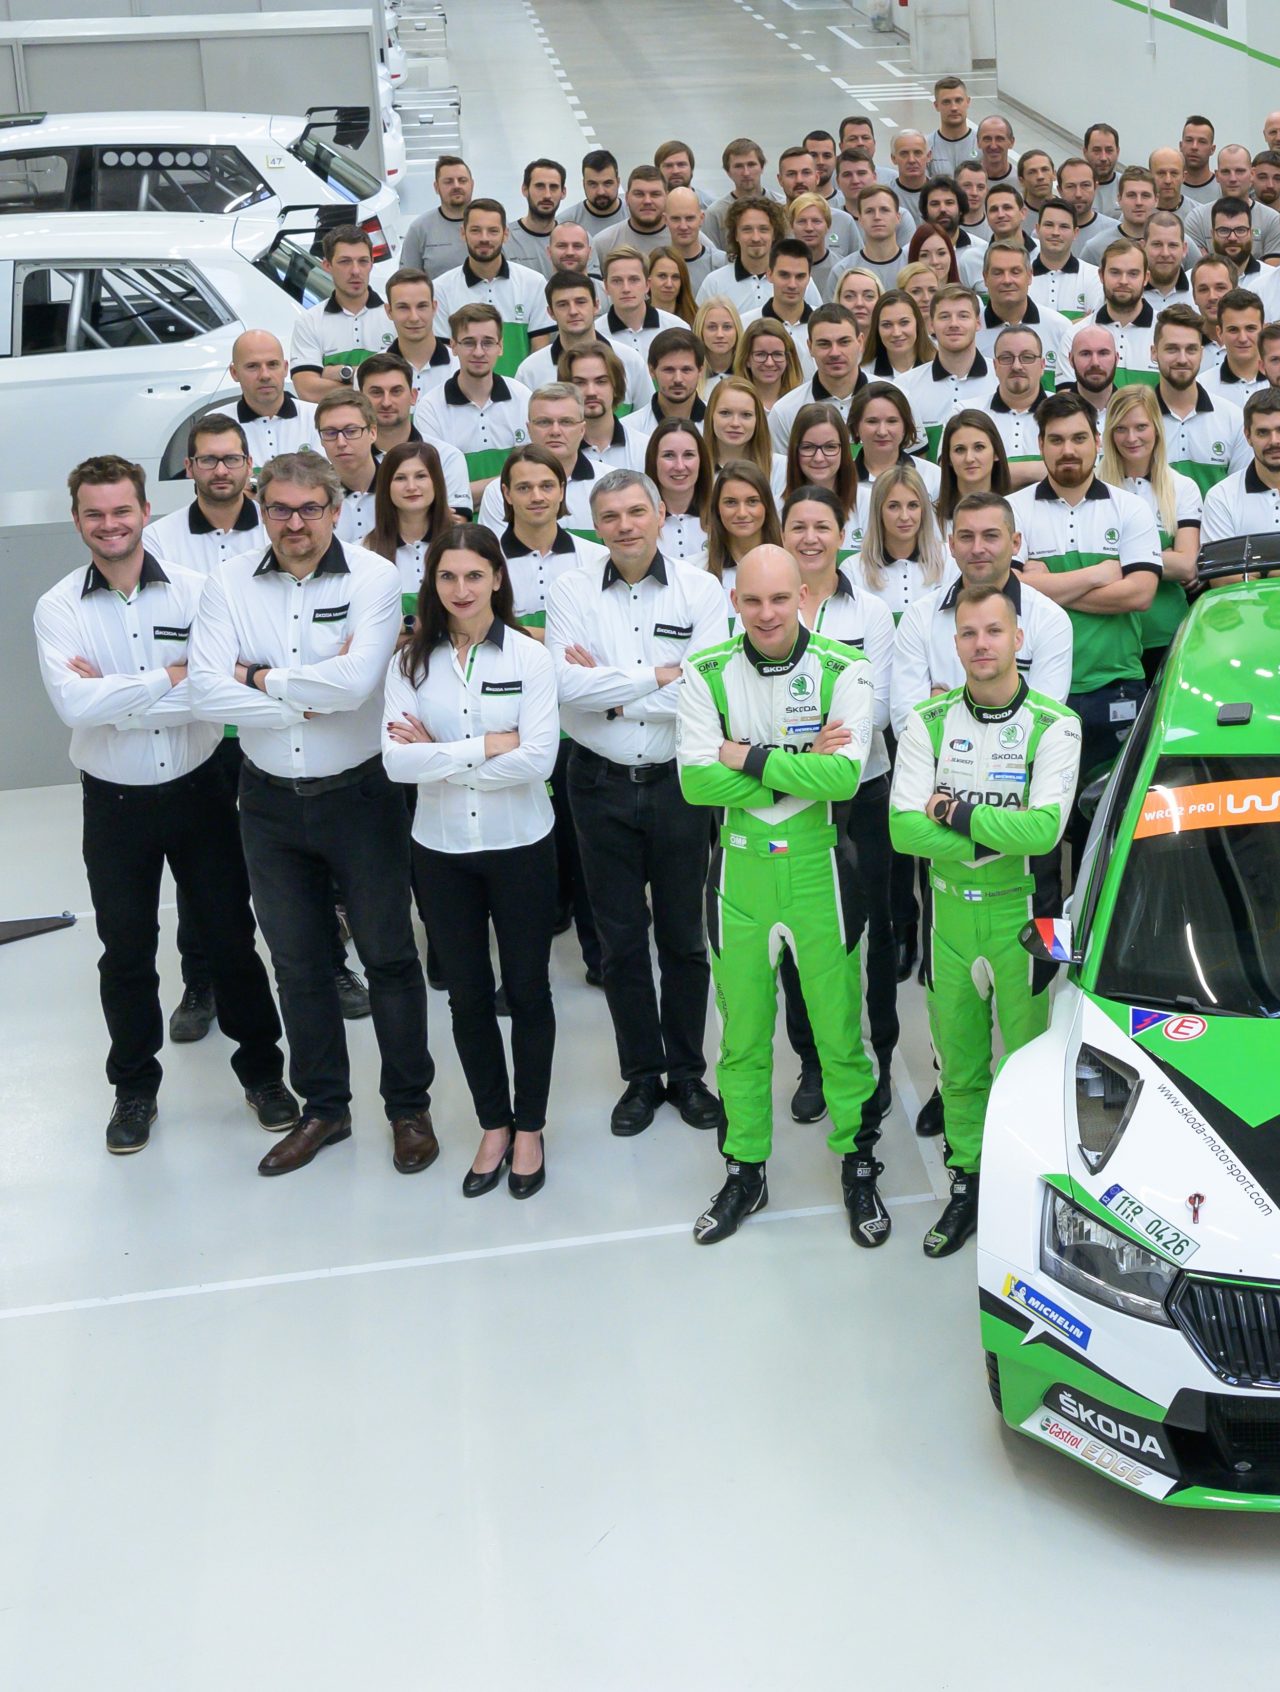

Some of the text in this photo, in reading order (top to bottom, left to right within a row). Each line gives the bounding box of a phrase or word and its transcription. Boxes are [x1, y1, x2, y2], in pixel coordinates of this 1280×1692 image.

[270, 157, 283, 166] 47
[699, 661, 719, 672] OMP
[785, 705, 818, 714] ŠKODA
[936, 782, 1022, 809] ŠKODA
[1188, 803, 1216, 815] PRO
[730, 837, 747, 847] OMP
[1173, 1019, 1200, 1036] E
[1157, 1083, 1273, 1217] www.skoda-motorsport.com
[1115, 1194, 1190, 1257] 11R 0426
[1028, 1295, 1084, 1339] MICHELIN
[1059, 1391, 1166, 1460] ŠKODA
[1048, 1422, 1152, 1486] Castrol EDGE
